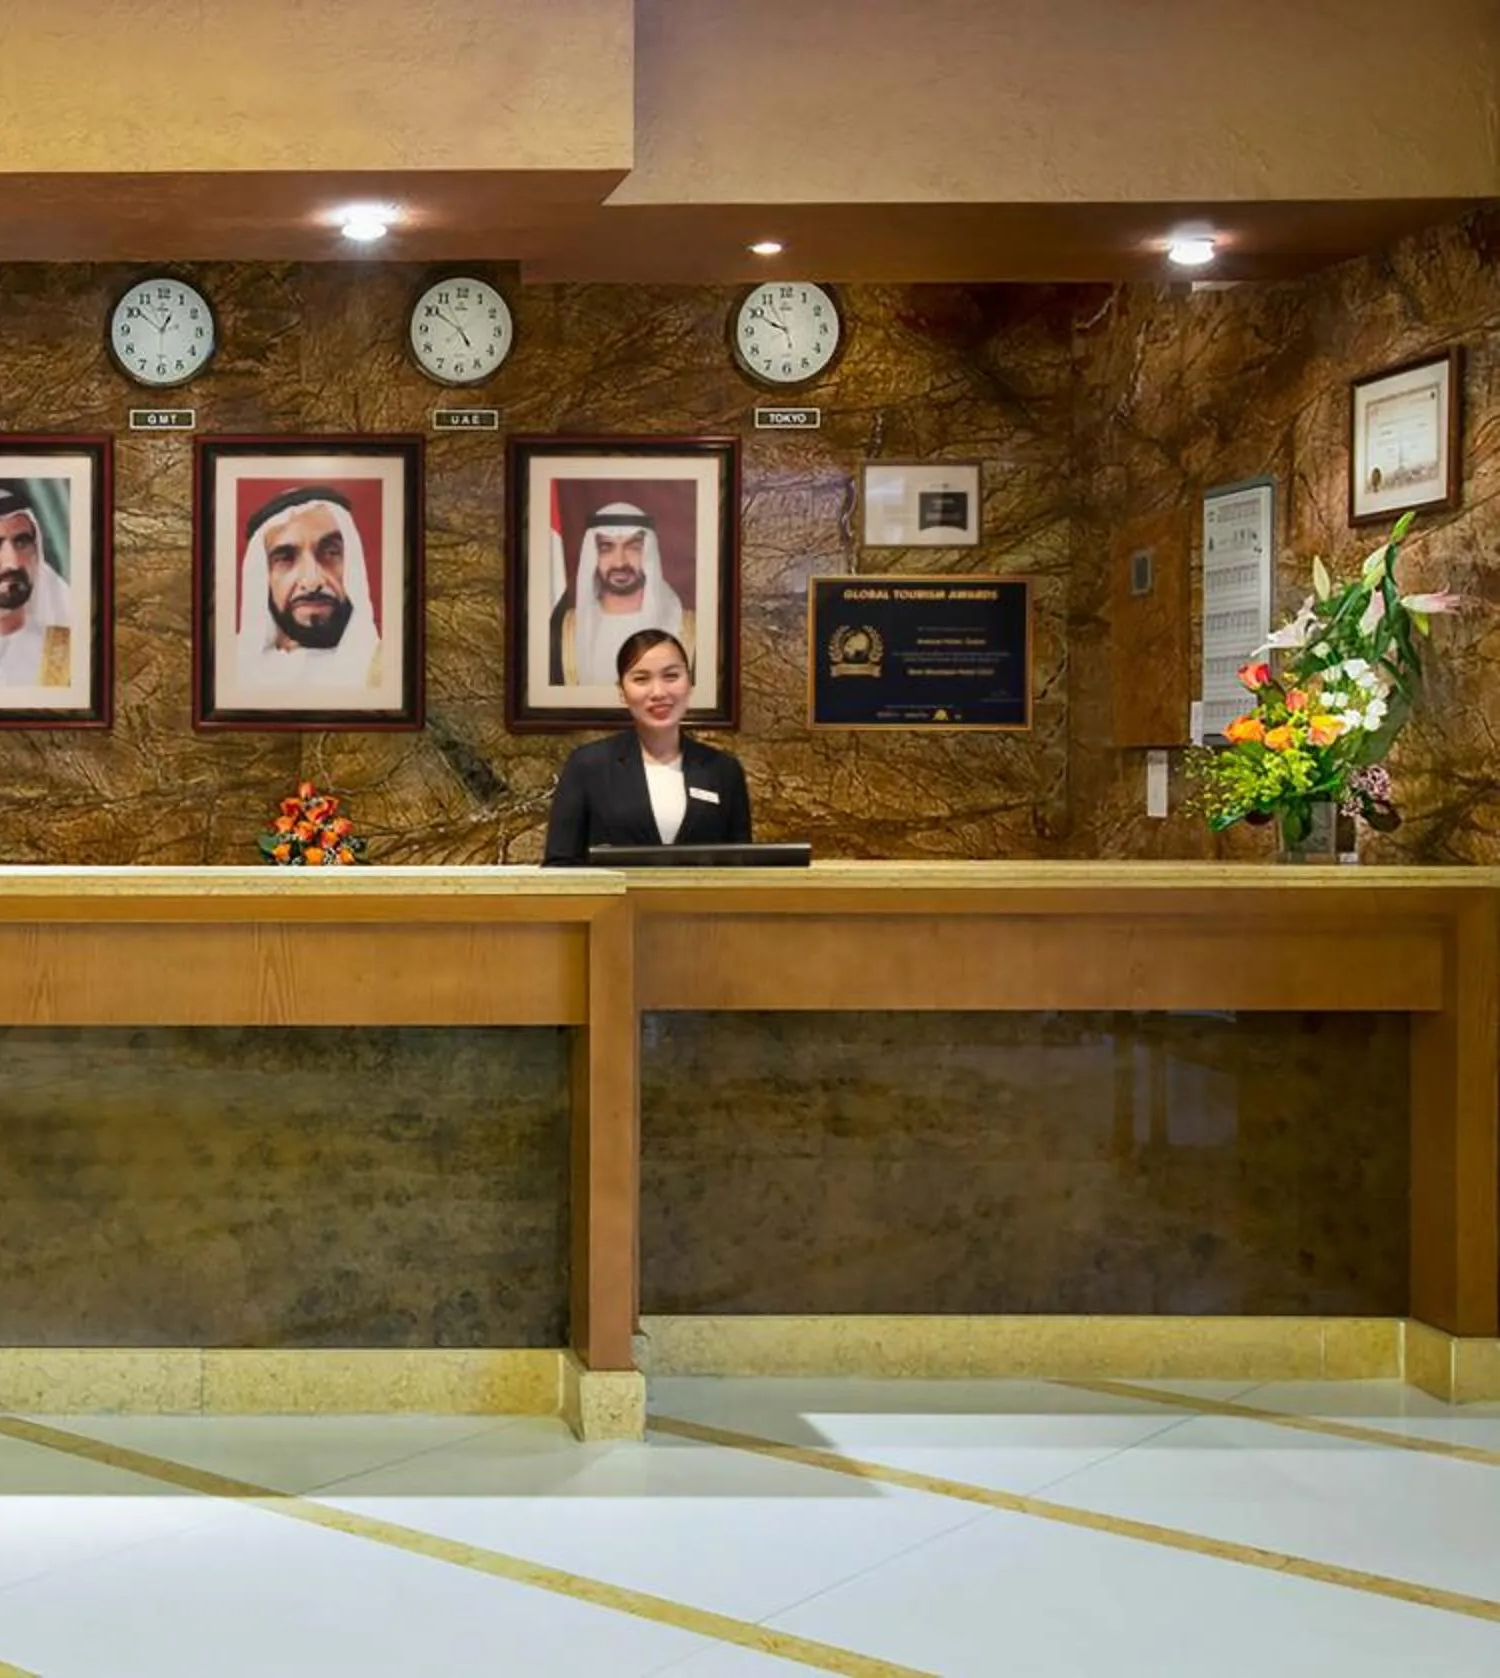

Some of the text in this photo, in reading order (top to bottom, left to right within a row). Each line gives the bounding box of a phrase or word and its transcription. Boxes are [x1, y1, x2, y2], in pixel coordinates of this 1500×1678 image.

[147, 414, 178, 425] GMT
[451, 414, 481, 425] UAE
[769, 412, 807, 424] TOKYO
[843, 589, 998, 601] GLOBAL TOURISM AWARDS
